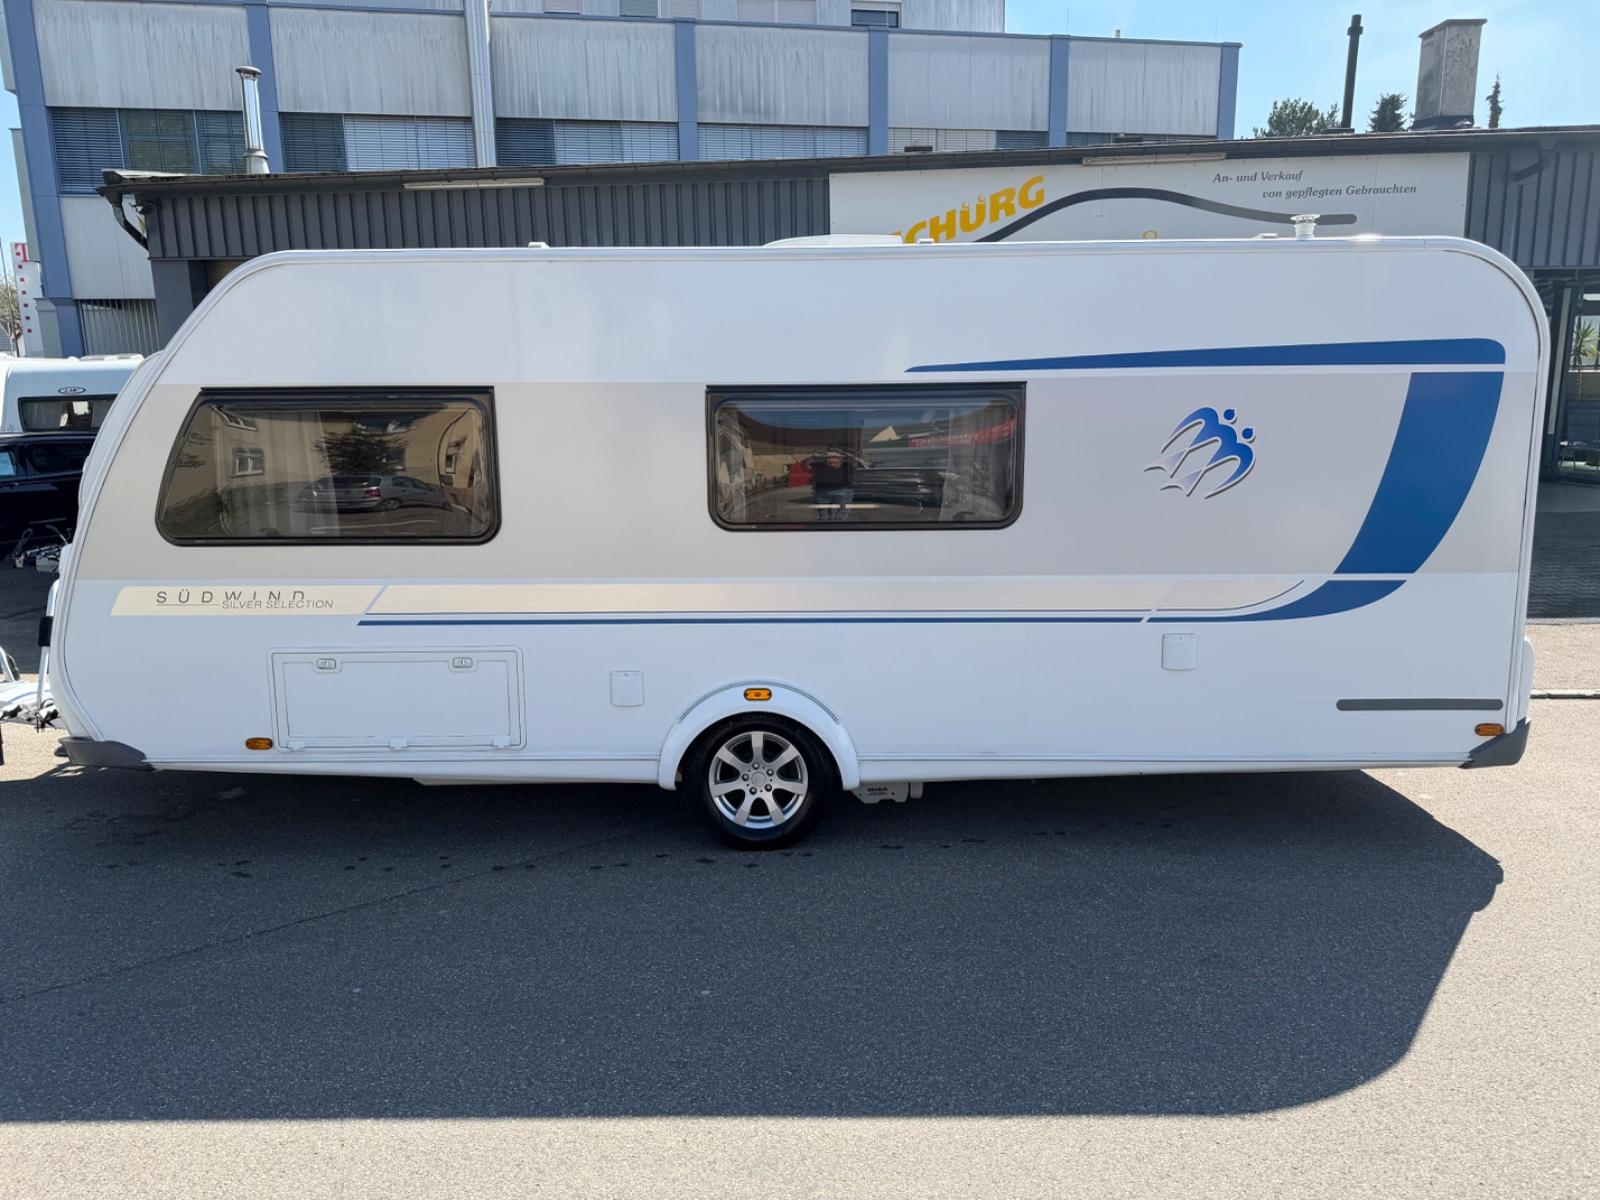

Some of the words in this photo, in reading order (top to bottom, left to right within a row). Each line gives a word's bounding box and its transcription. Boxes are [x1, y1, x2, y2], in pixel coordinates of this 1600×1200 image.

[1213, 173, 1232, 183] An-
[1236, 171, 1257, 182] und
[1261, 170, 1304, 182] Verkauf
[1262, 190, 1282, 198] von
[1285, 187, 1342, 199] gepflegten
[1345, 184, 1417, 195] Gebrauchten
[890, 175, 1045, 244] CHÜRG
[222, 600, 262, 609] SILVER
[265, 600, 334, 609] SELECTION
